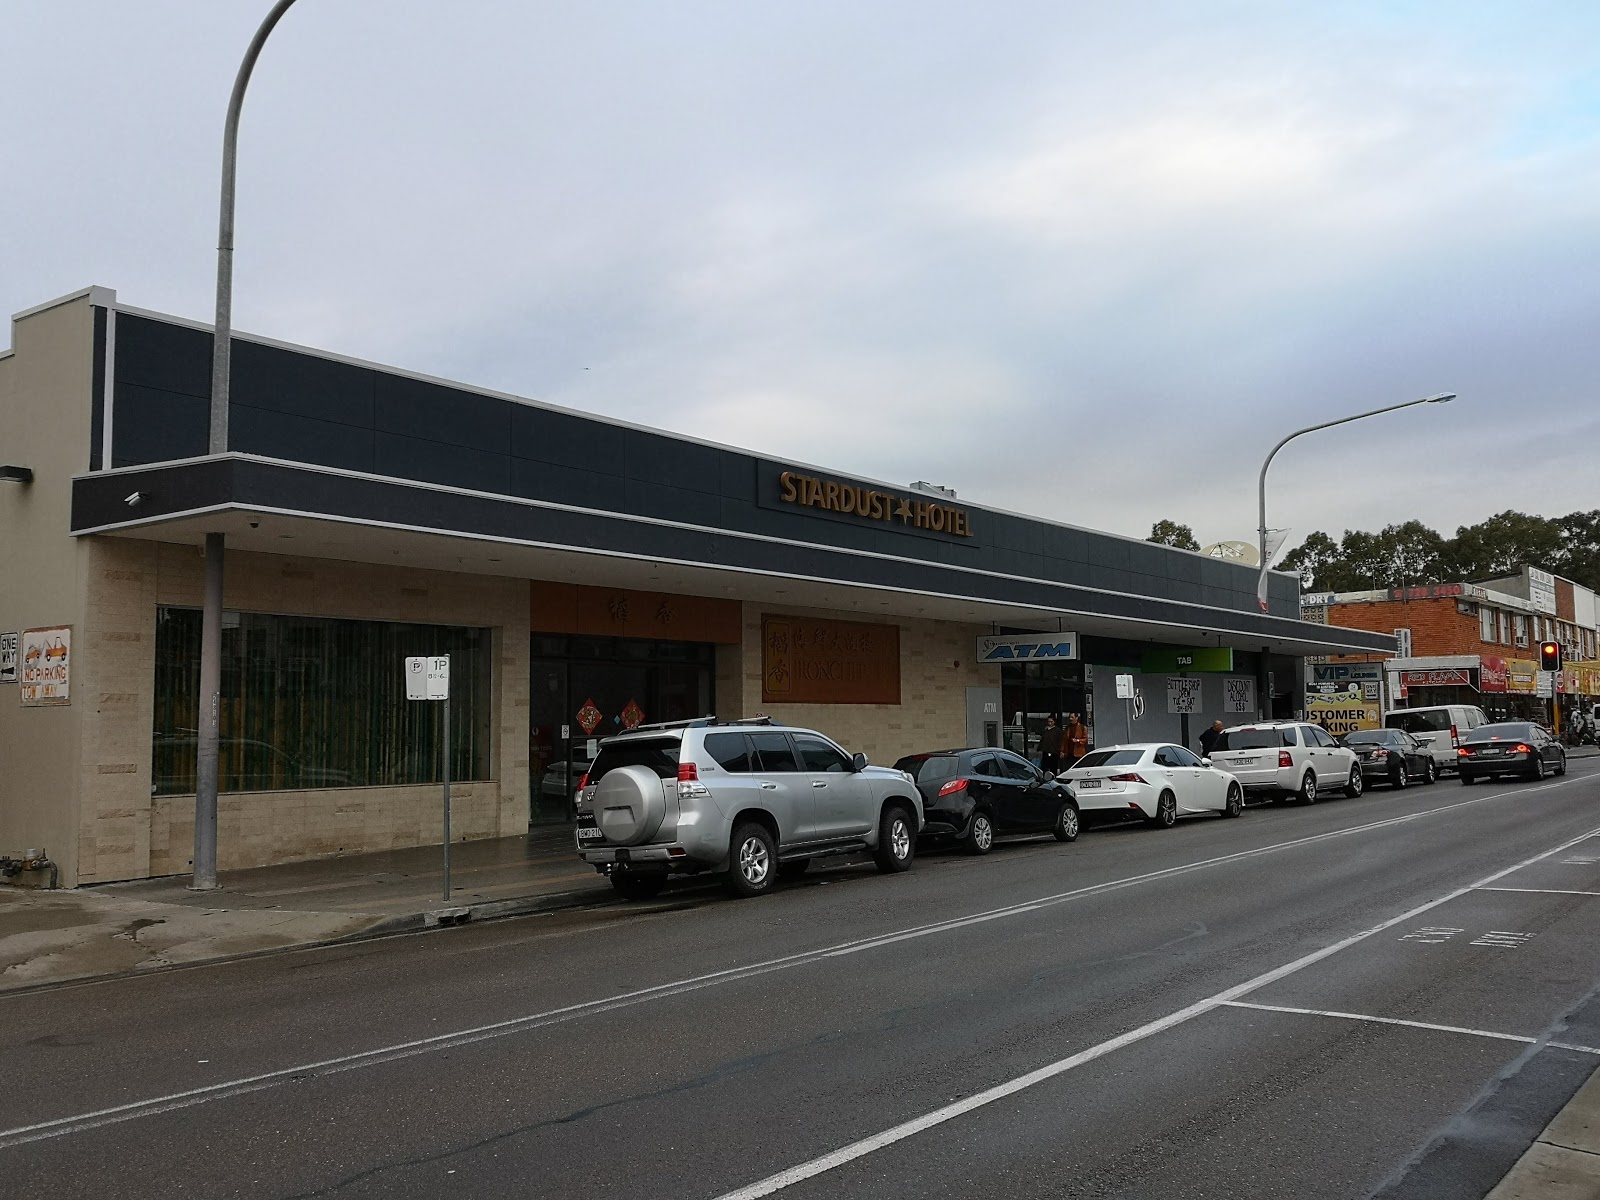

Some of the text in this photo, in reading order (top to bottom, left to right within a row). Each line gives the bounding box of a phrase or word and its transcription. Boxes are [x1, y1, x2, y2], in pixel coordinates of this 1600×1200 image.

[781, 471, 974, 537] STARDUST HOTEL
[2, 638, 17, 650] ONE
[3, 651, 16, 663] WAY
[984, 643, 1071, 660] ATM
[434, 660, 447, 671] 1P
[1176, 656, 1192, 665] TAB
[25, 666, 66, 681] NO PARKING
[1314, 667, 1350, 679] VIP
